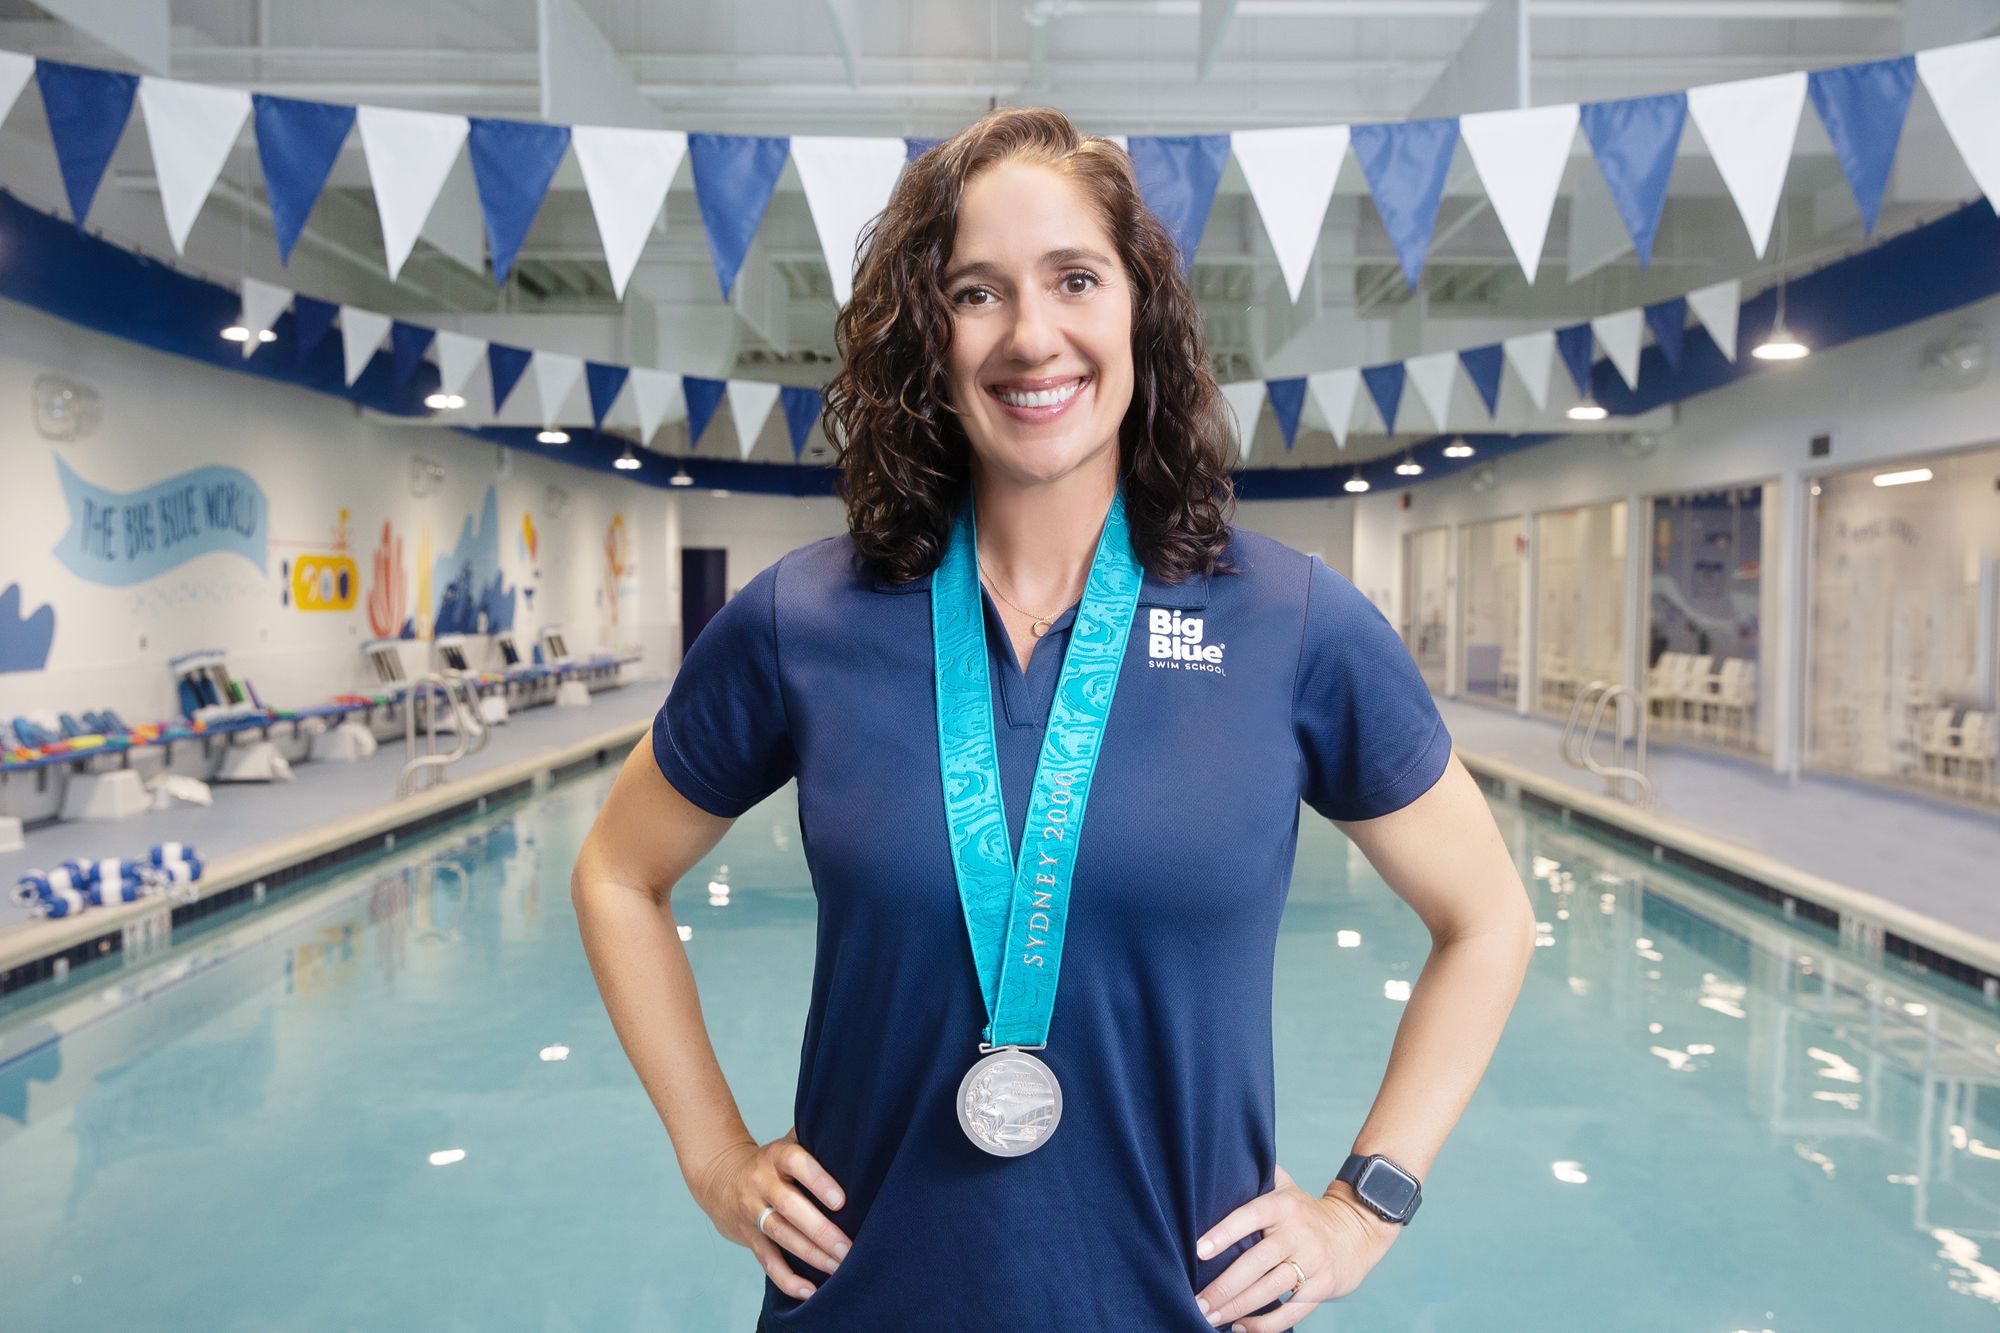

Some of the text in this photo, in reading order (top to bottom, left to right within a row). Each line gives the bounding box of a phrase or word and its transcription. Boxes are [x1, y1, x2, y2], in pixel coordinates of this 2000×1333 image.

[81, 481, 258, 562] THE BIG BLUE WORLD
[1149, 608, 1204, 645] Big
[1148, 660, 1227, 677] SWIM SCHOOL
[1023, 773, 1075, 968] SYDNEY 2000
